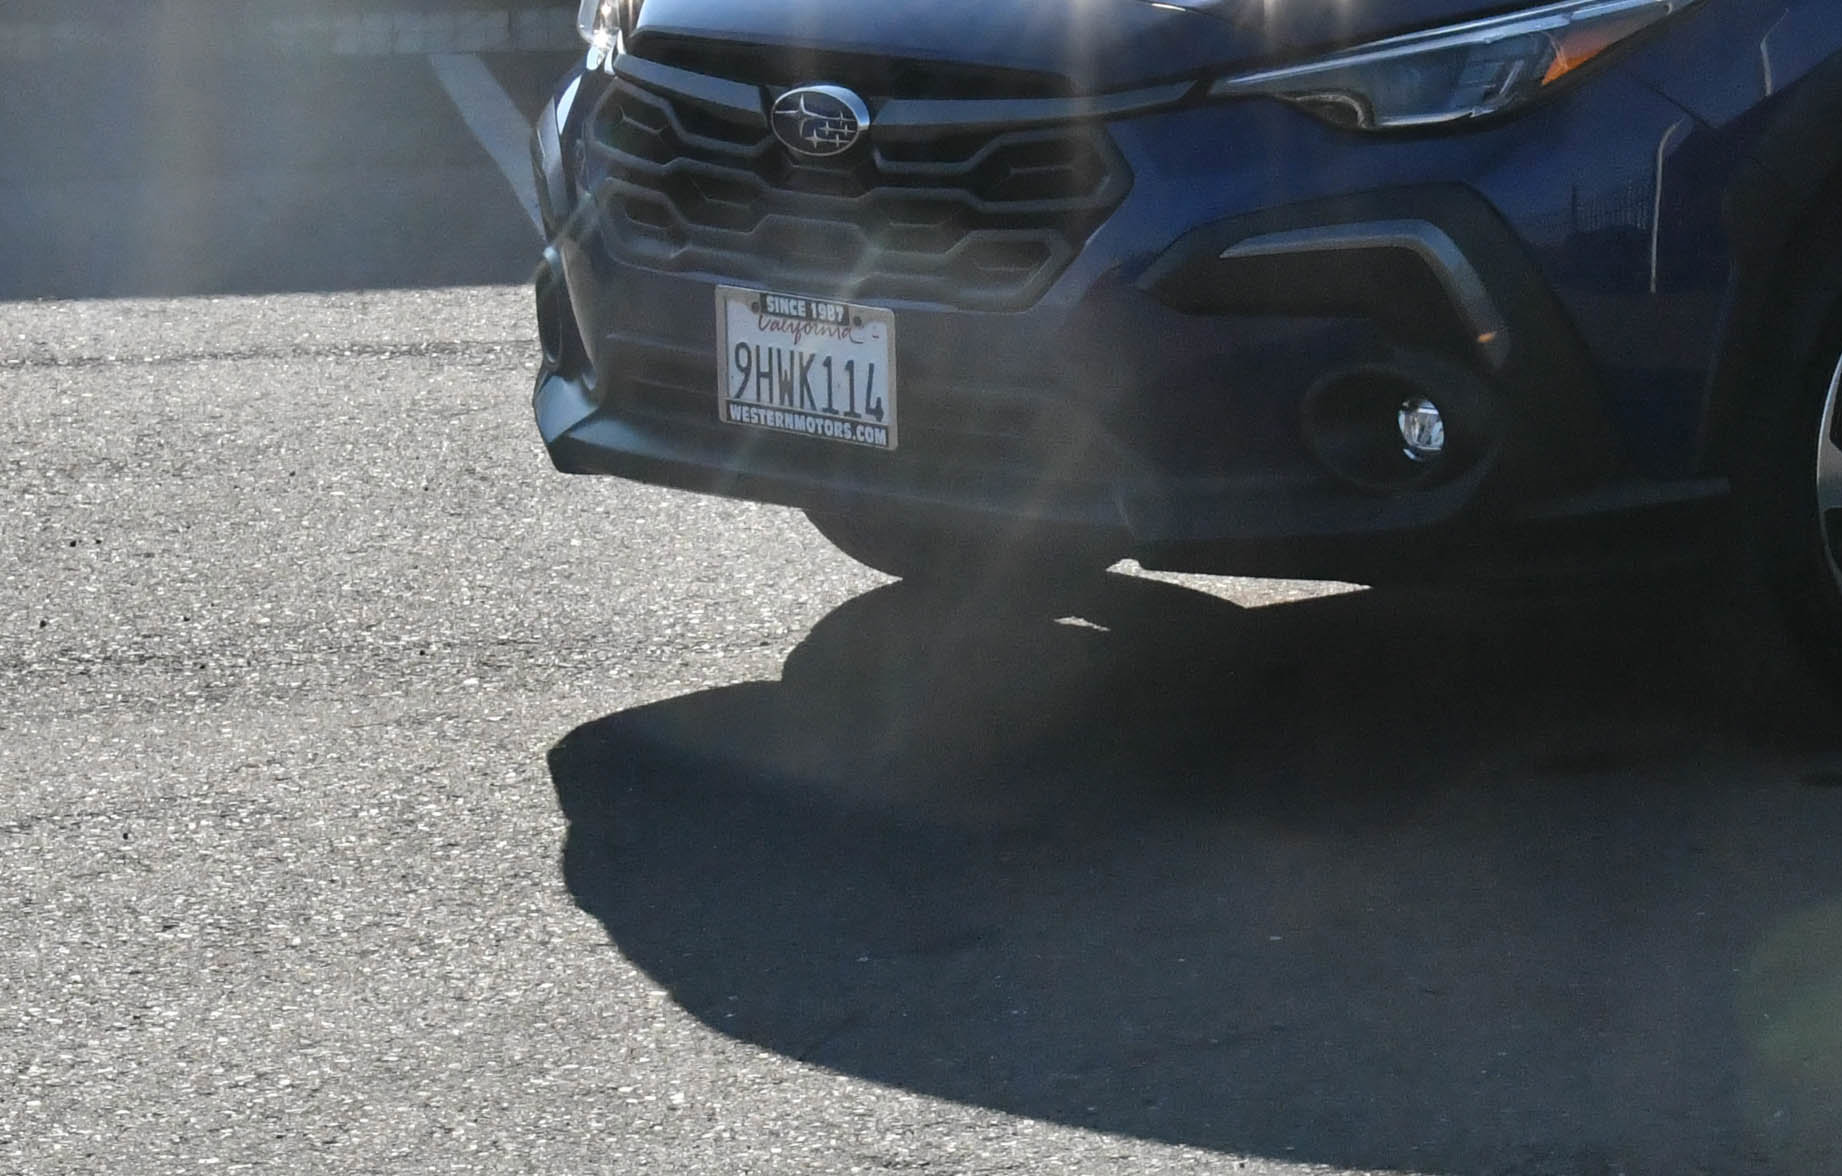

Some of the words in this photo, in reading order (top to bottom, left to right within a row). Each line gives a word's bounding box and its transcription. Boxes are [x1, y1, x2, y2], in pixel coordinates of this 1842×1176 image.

[766, 295, 806, 319] SINCE
[811, 302, 845, 322] 1987
[734, 341, 885, 423] 9HWK114
[729, 404, 887, 445] WESTERNMOTORS.COM
